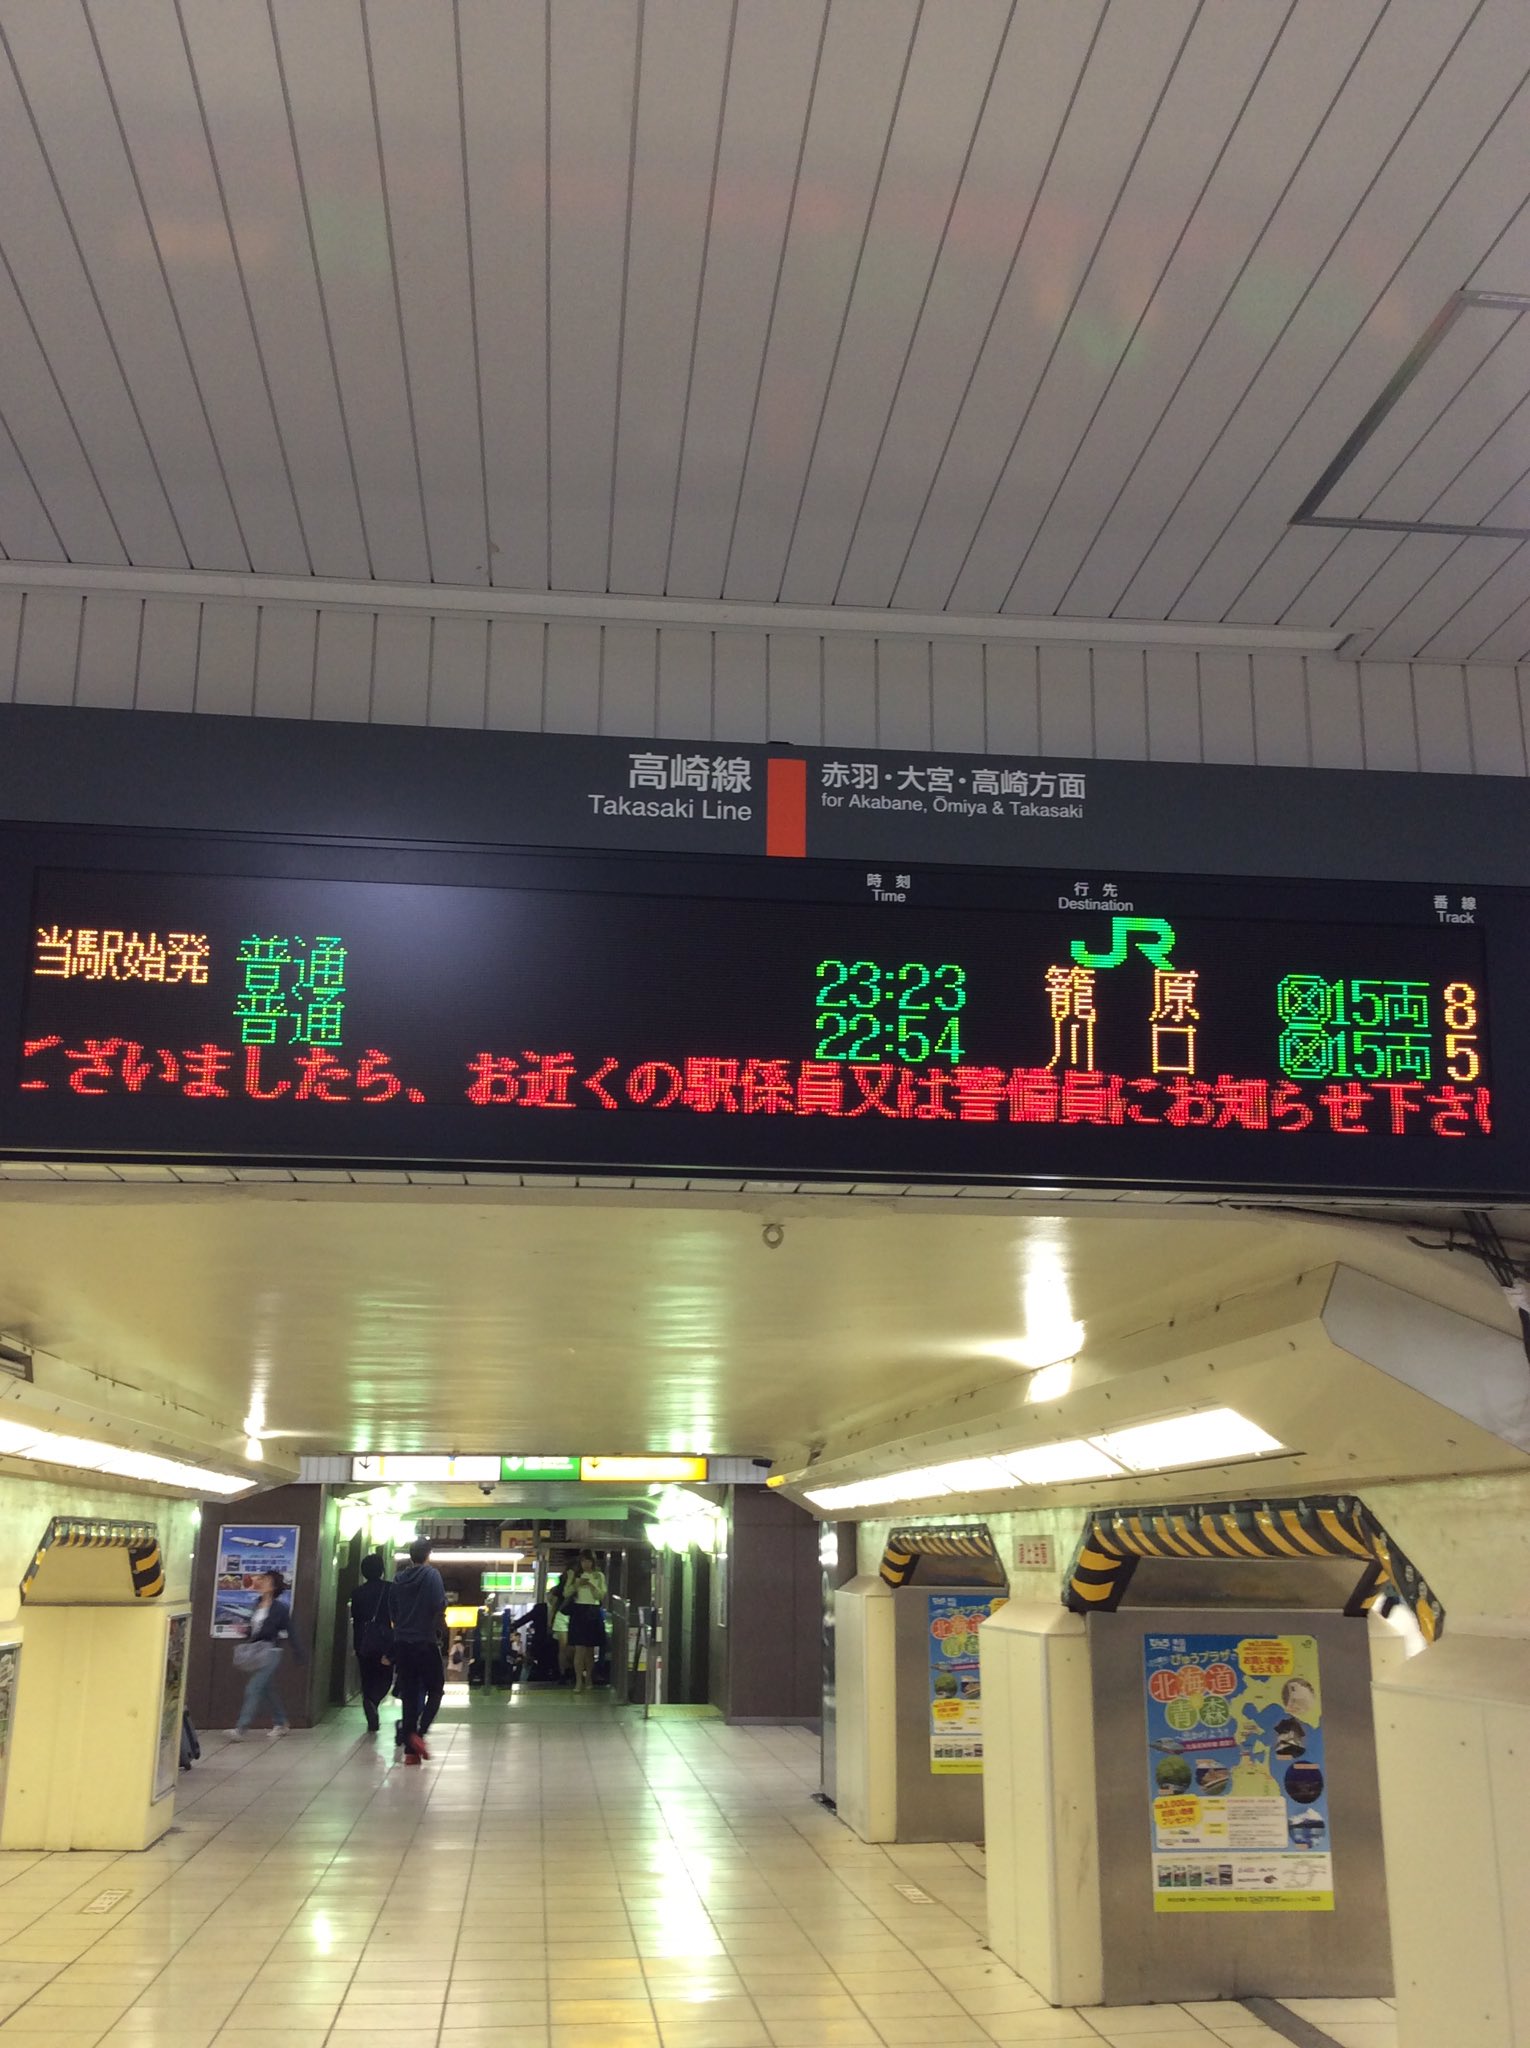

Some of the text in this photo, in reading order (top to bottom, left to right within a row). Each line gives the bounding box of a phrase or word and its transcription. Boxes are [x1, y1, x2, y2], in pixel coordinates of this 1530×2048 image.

[628, 752, 752, 793] 高崎線
[820, 761, 1086, 799] 赤羽・大宮・高崎方面
[588, 794, 752, 821] Takasaki Line
[821, 792, 844, 807] for
[848, 793, 927, 814] Akabane,
[991, 800, 1005, 815] &
[1009, 801, 1083, 819] Takasaki
[866, 873, 911, 889] 時刻
[871, 889, 906, 903] Time
[1073, 881, 1119, 898] 行先
[1057, 896, 1134, 912] Destination
[1433, 895, 1477, 910] 番線
[1436, 910, 1475, 924] Track
[34, 923, 210, 985] 当駅始発
[1070, 916, 1176, 970] JR
[235, 933, 348, 995] 普通
[815, 960, 966, 1011] 23:23
[233, 987, 346, 1046] 普通
[1443, 982, 1477, 1030] 8
[815, 1012, 966, 1064] 22:54
[1445, 1033, 1480, 1082] 5
[1152, 1666, 1234, 1701] 北海道
[1168, 1697, 1229, 1729] 青森
